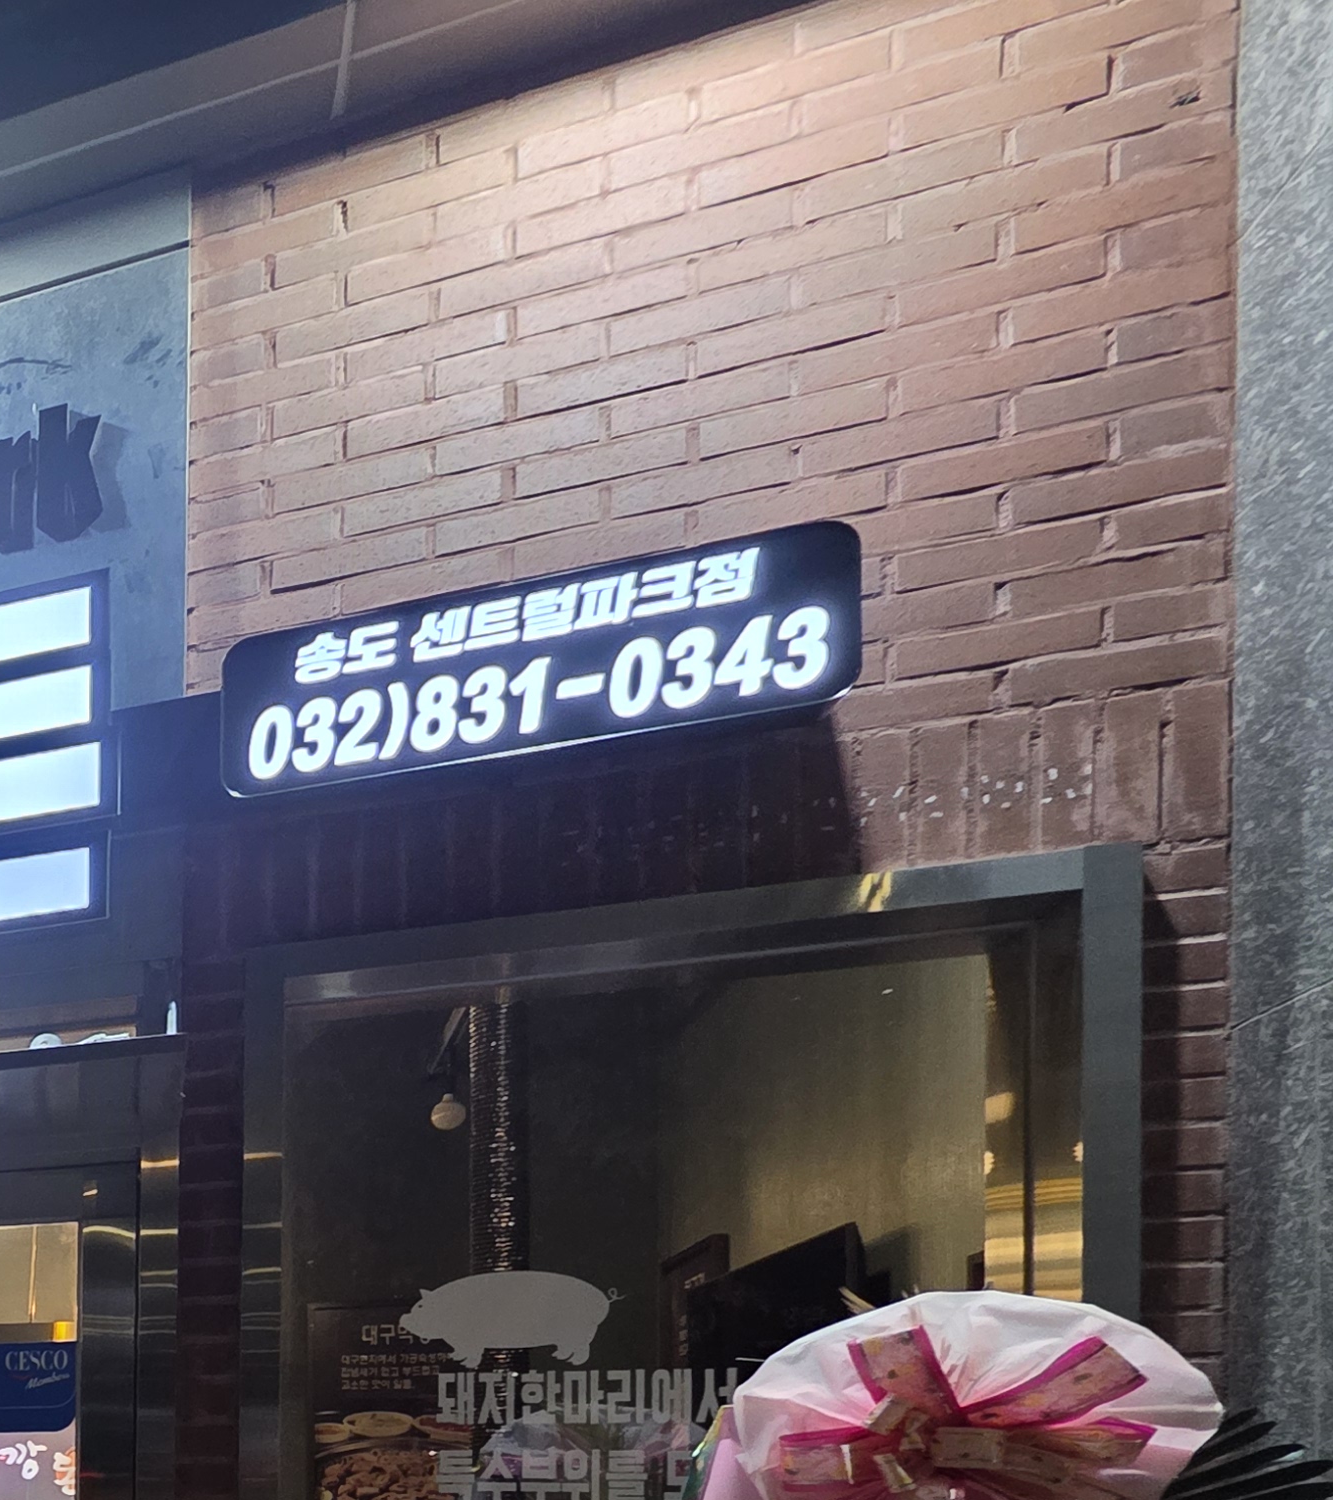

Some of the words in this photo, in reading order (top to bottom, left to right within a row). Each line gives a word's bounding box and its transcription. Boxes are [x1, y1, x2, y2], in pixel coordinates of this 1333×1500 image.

[294, 620, 399, 685] 송도
[410, 547, 761, 664] 센트럴파크점
[247, 605, 832, 781] 032)831-0343
[4, 1349, 69, 1373] CESCO
[360, 1323, 431, 1346] 대구막
